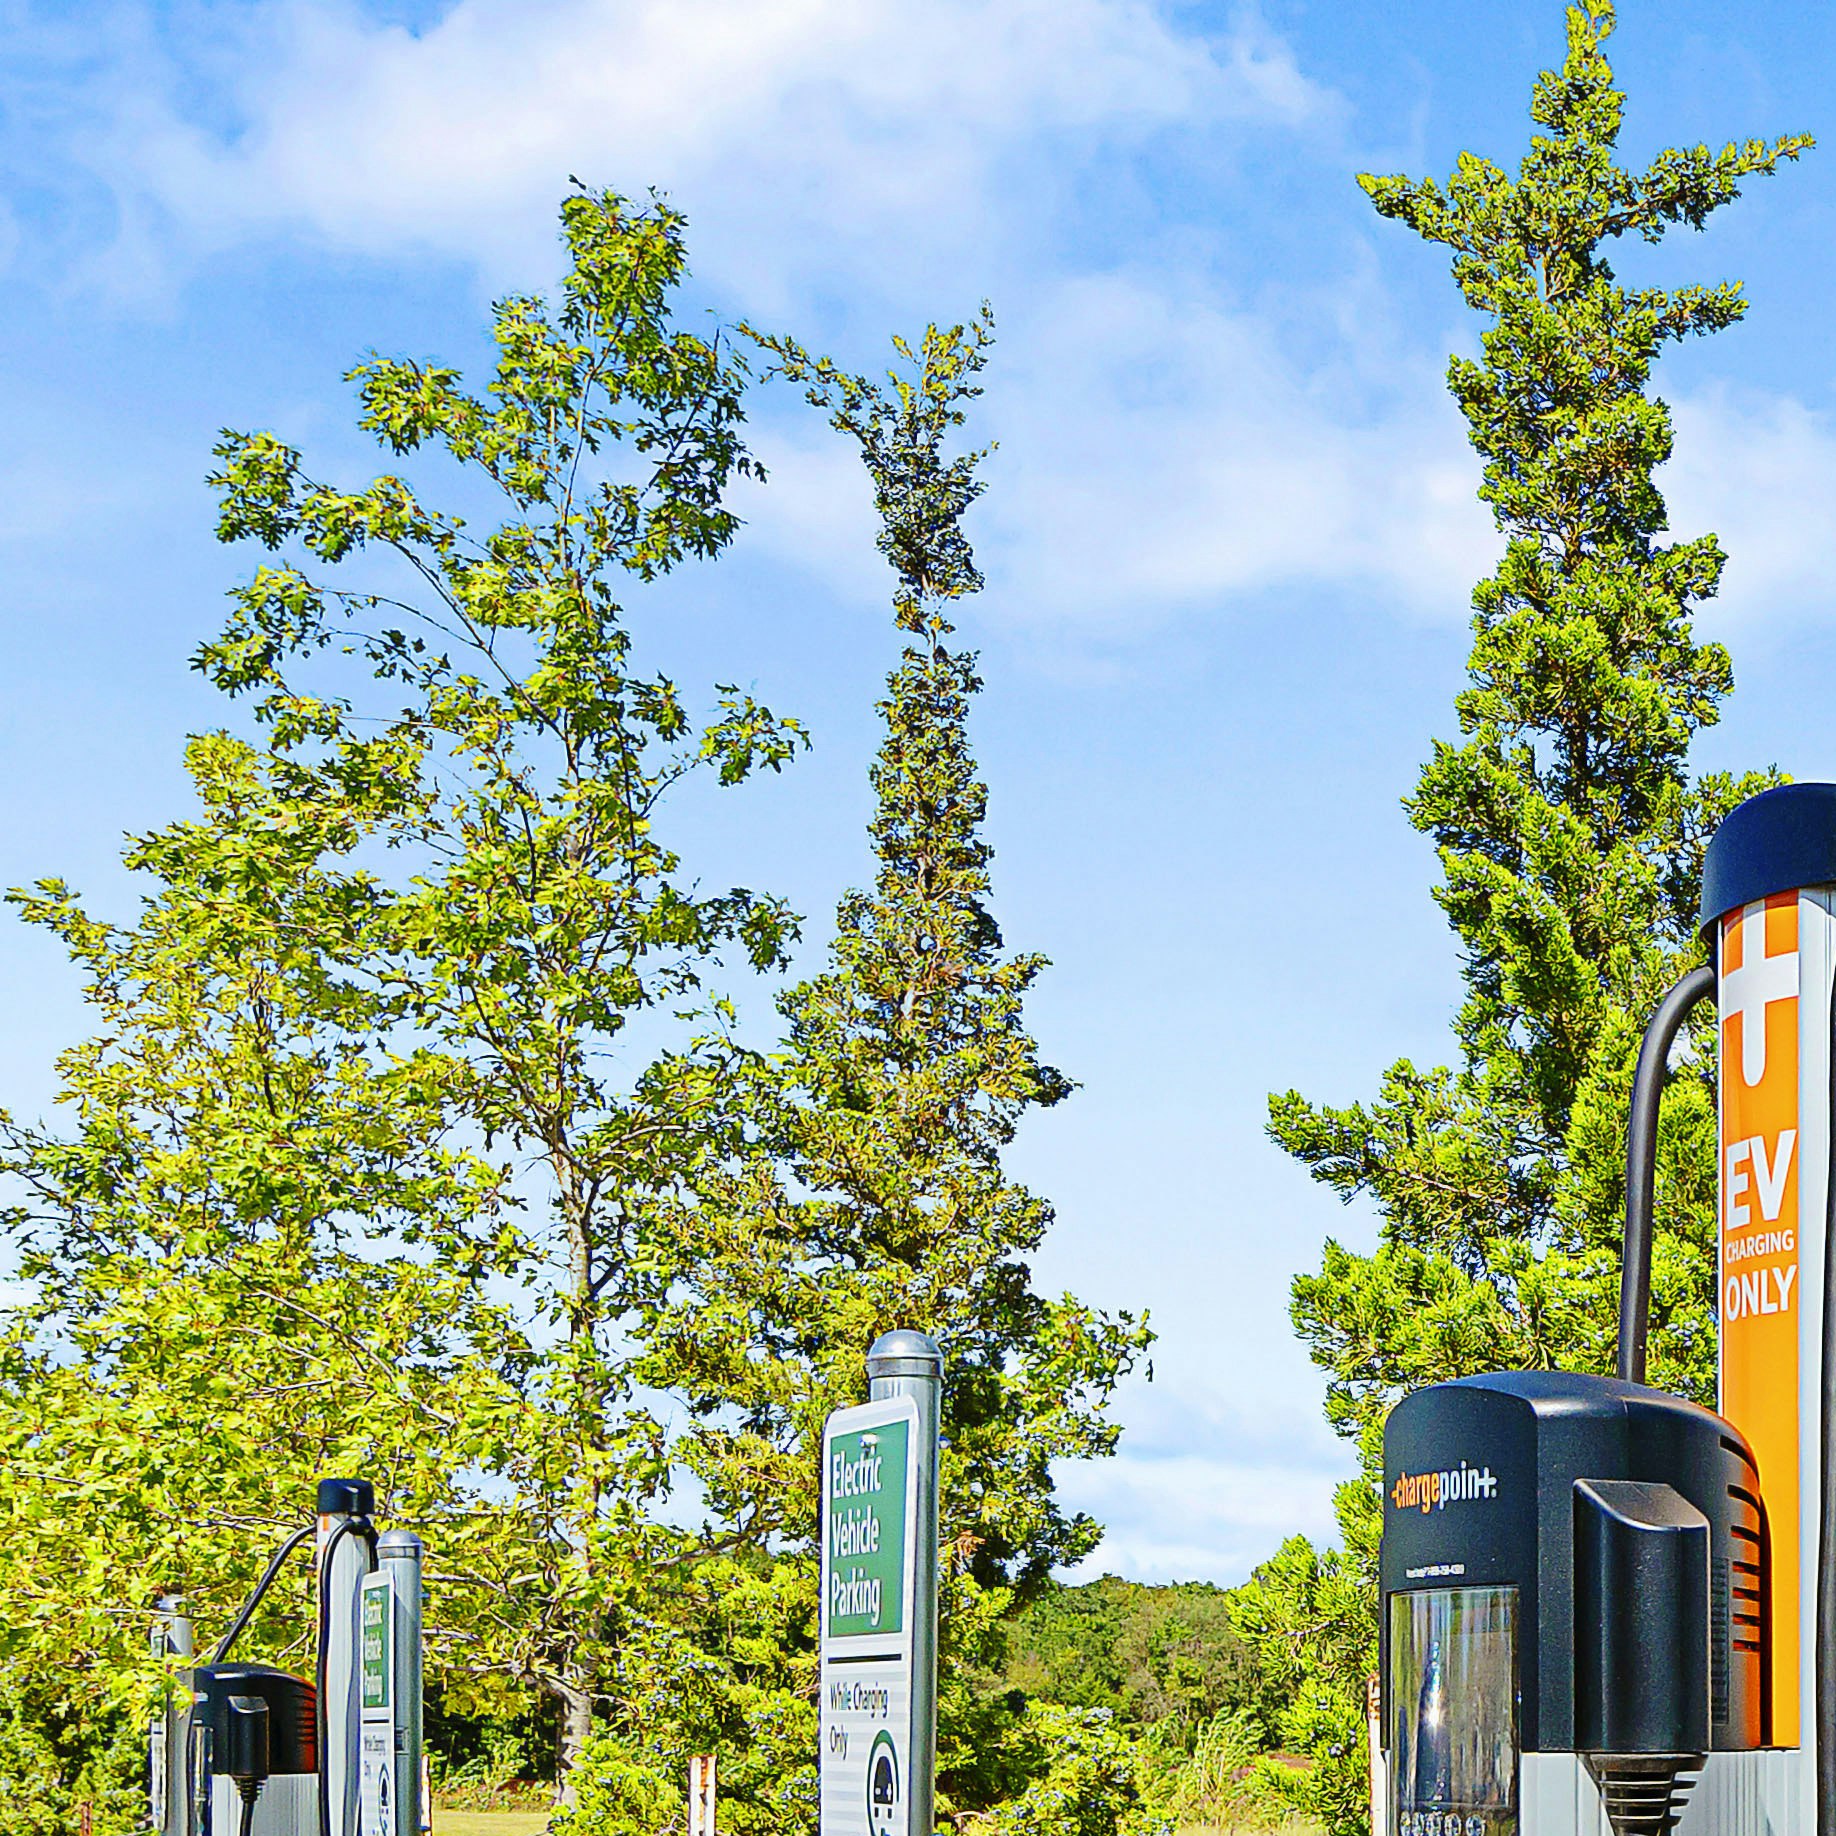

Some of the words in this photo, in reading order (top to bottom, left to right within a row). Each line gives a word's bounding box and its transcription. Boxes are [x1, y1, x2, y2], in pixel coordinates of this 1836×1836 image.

[1727, 1129, 1796, 1230] EV
[1727, 1229, 1794, 1264] CHARGING
[1726, 1265, 1796, 1321] ONLY
[832, 1446, 882, 1499] Electric
[832, 1505, 879, 1557] Vehicle
[832, 1567, 880, 1626] Parking
